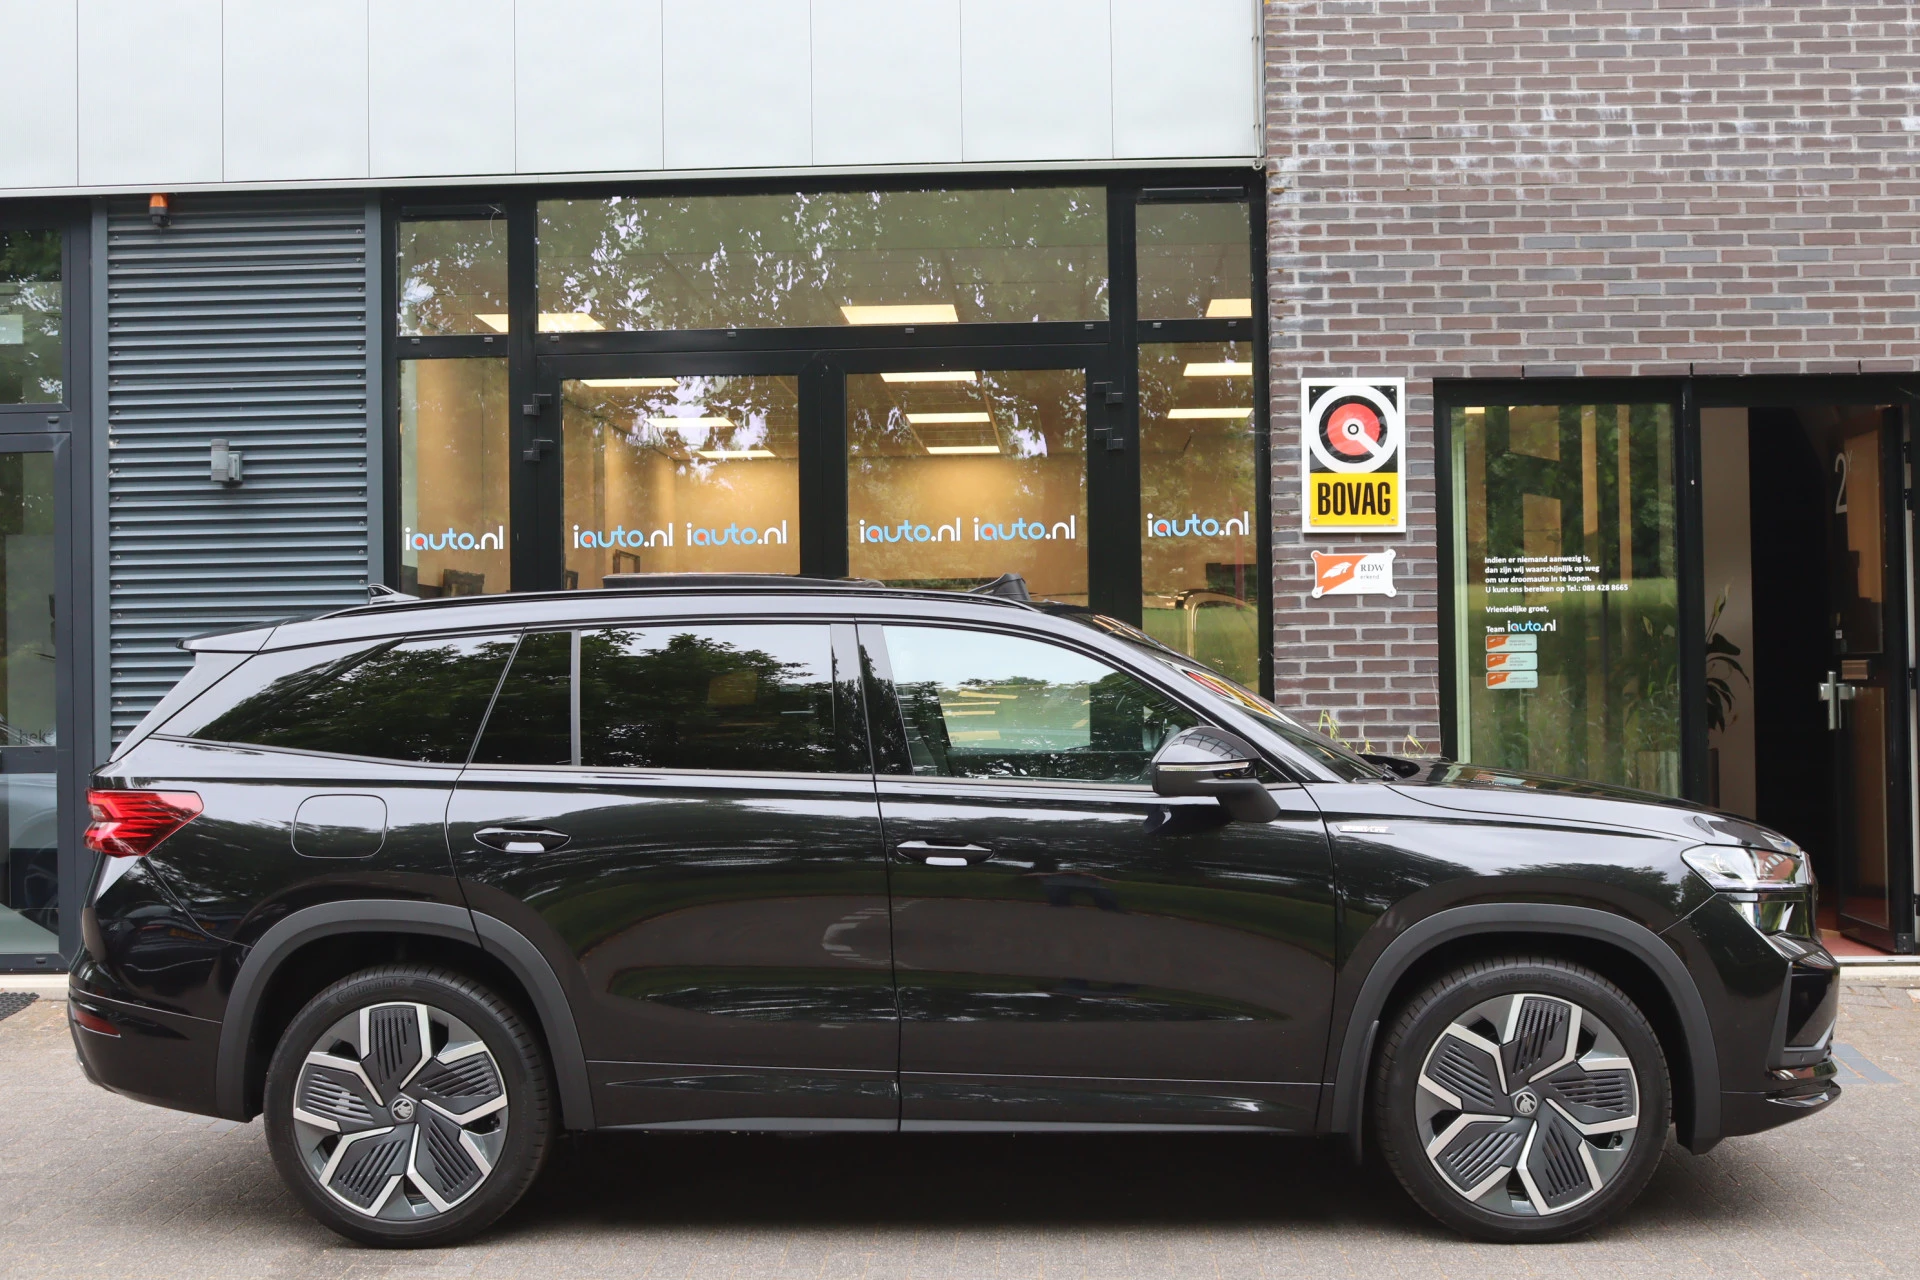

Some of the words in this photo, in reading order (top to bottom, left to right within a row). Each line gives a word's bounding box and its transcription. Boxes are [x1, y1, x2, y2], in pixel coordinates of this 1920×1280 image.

[1317, 481, 1391, 516] BOVAG
[859, 517, 961, 543] iauto.nl
[973, 514, 1076, 542] iauto.nl
[1146, 510, 1250, 538] iauto.nl
[404, 525, 504, 551] iauto.nl
[572, 522, 674, 549] iauto.nl
[686, 519, 787, 547] iauto.nl
[1549, 555, 1582, 563] aanwezig
[1360, 564, 1384, 572] RDW
[1500, 566, 1512, 574] zijn
[1513, 566, 1524, 574] wij
[1526, 565, 1573, 574] waarschijnlijk
[1568, 575, 1592, 583] kopen.
[1486, 606, 1527, 614] Vriendelijke
[1507, 619, 1557, 632] iauto.nl
